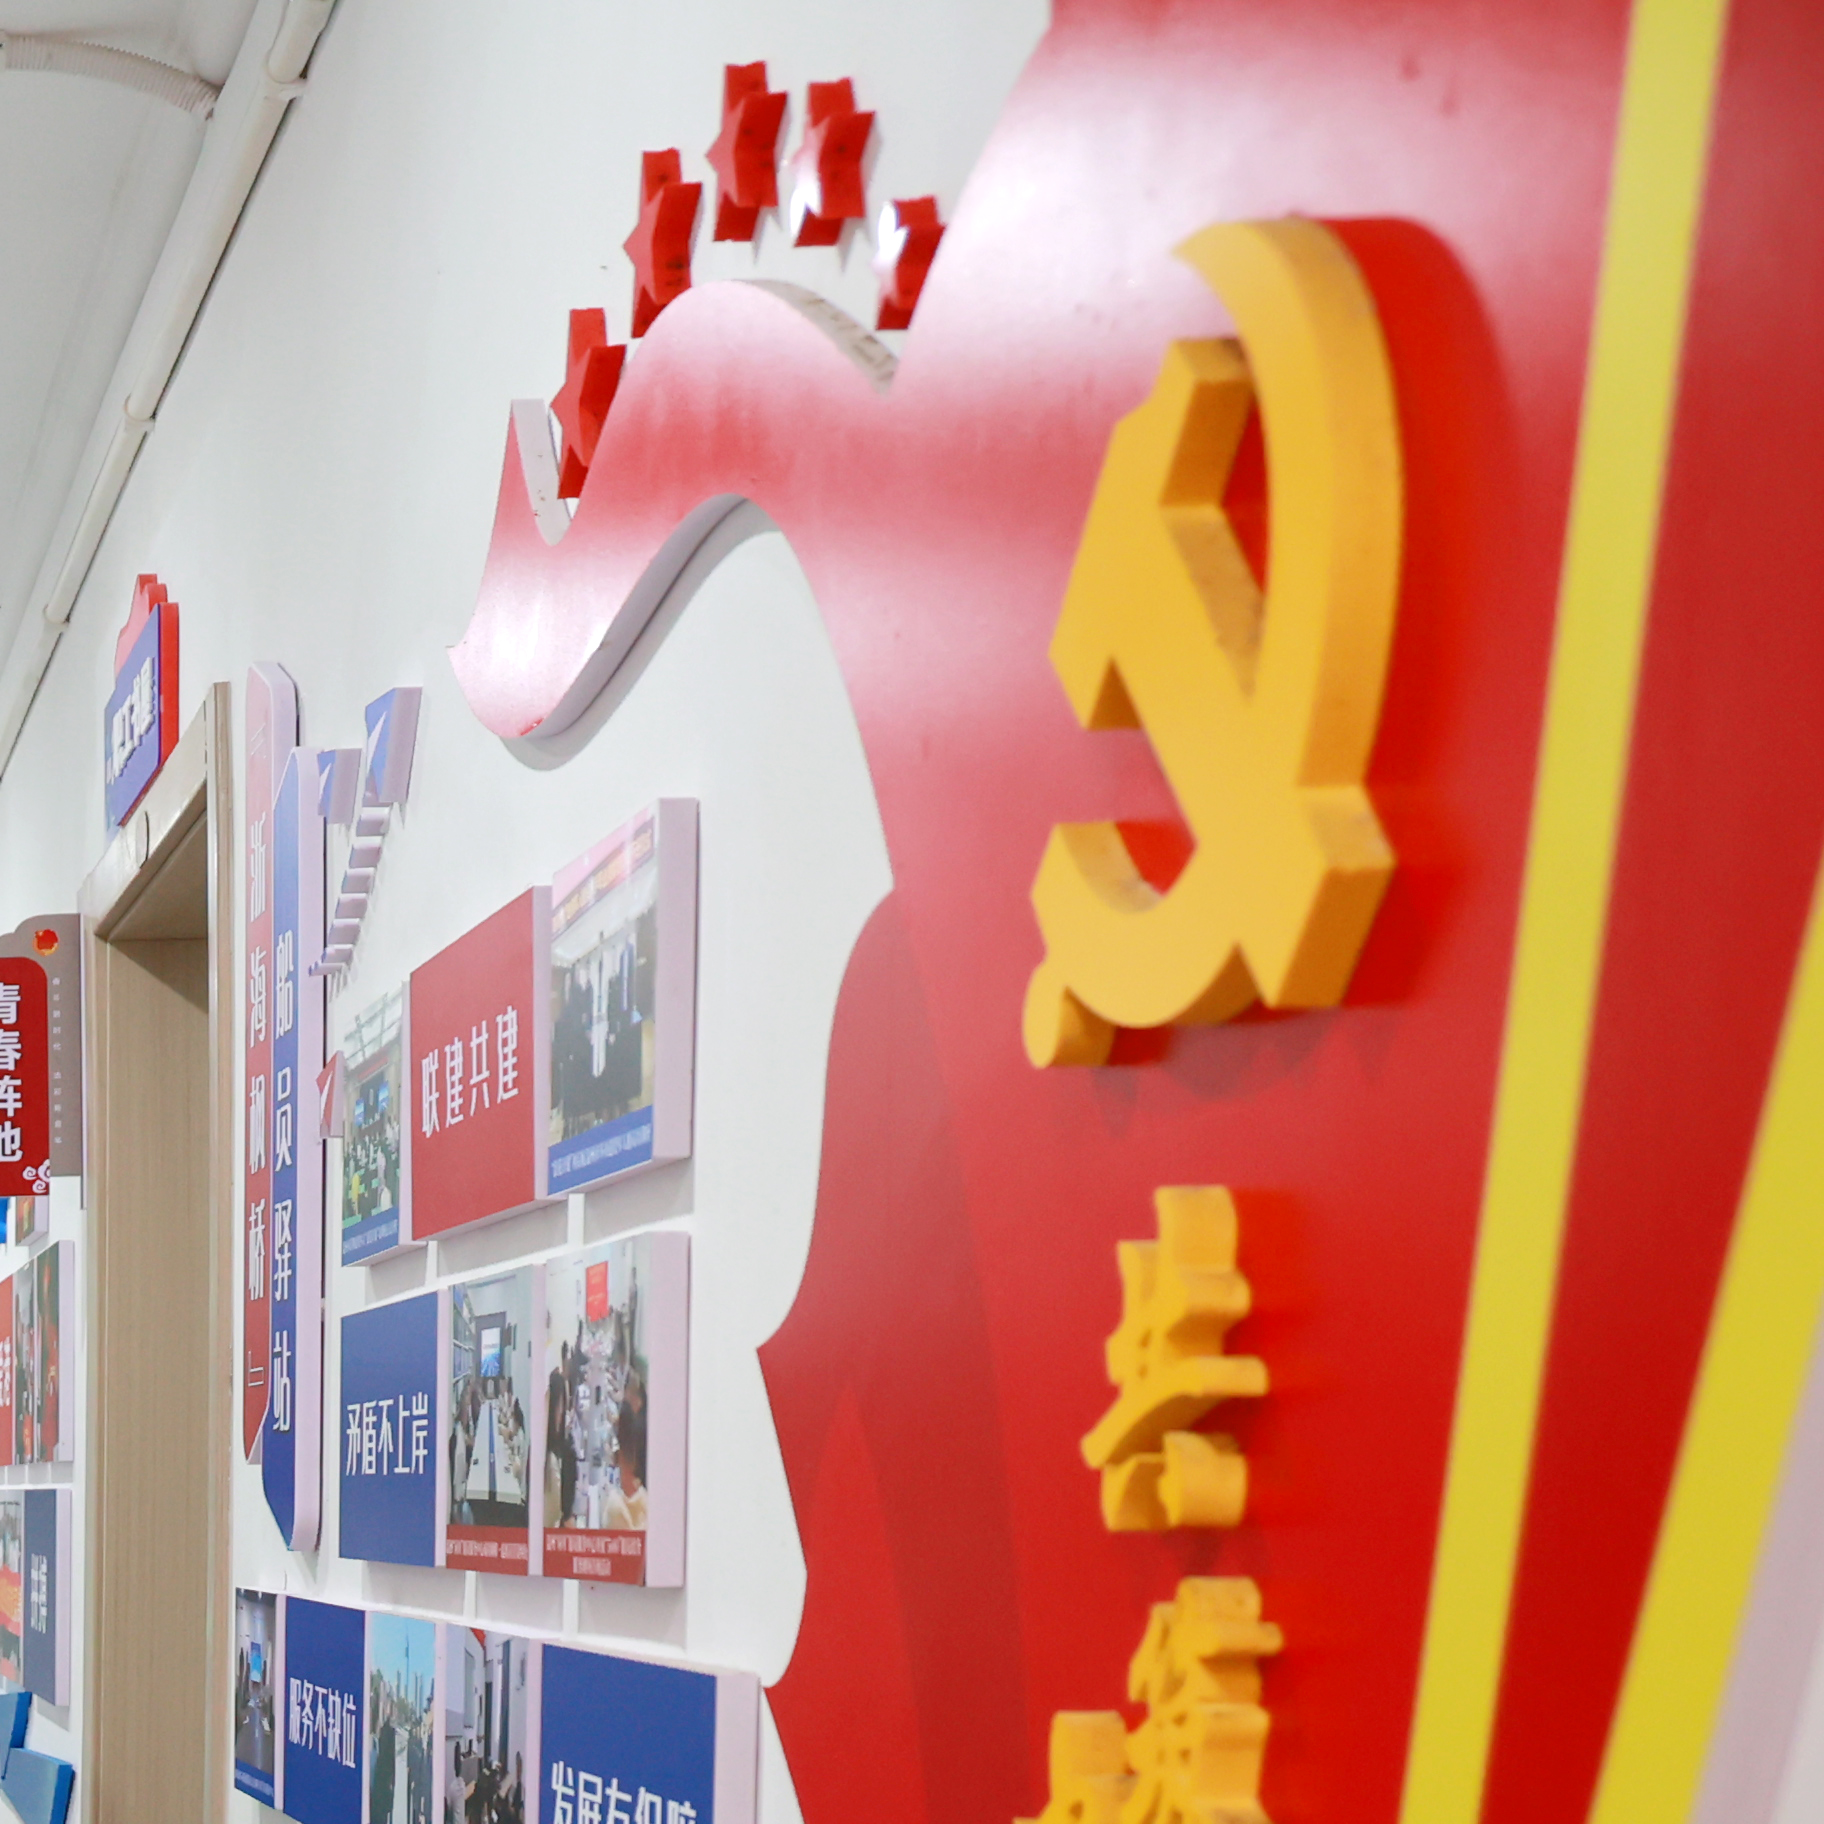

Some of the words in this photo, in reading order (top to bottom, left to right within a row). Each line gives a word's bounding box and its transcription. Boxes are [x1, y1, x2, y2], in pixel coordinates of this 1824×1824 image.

[421, 1004, 519, 1139] 联建共建
[273, 929, 294, 1432] 船员驿站
[346, 1393, 430, 1477] 矛盾不上岸
[288, 1676, 357, 1772] 服务不缺位
